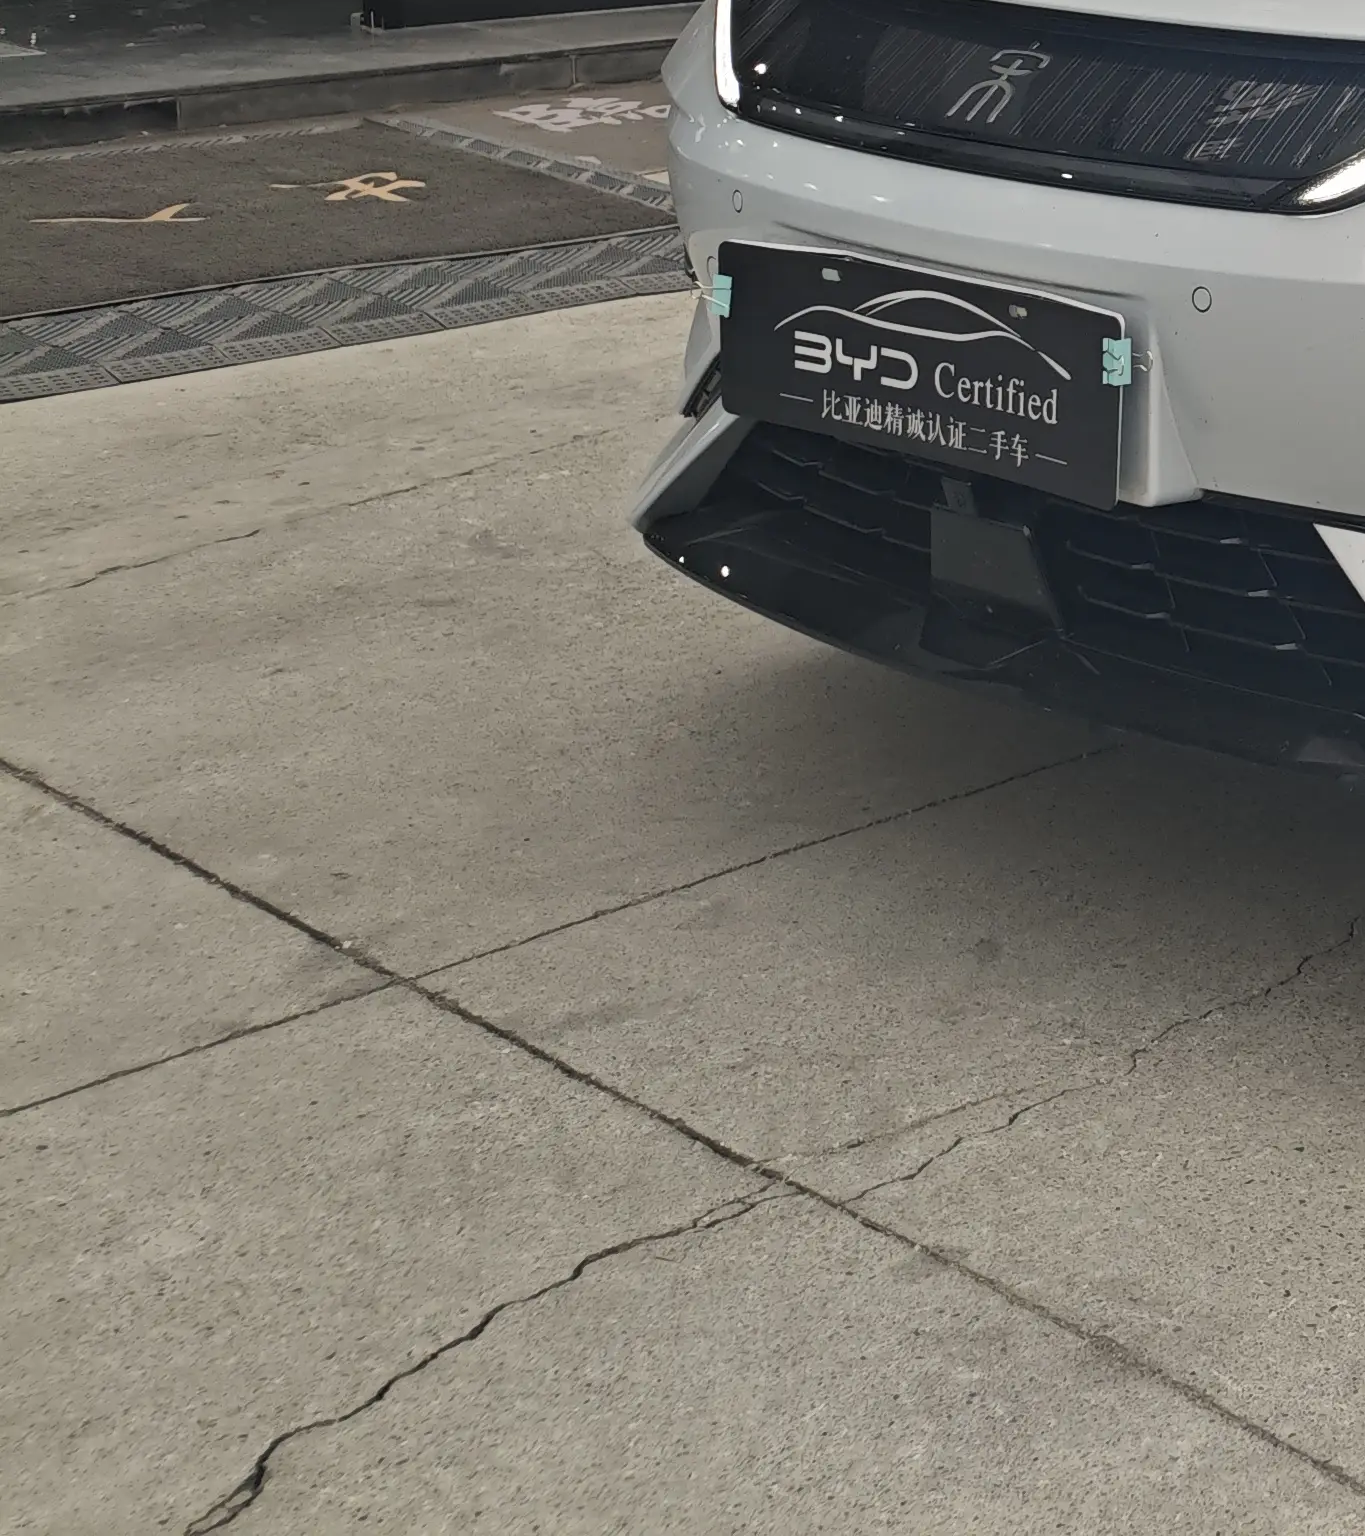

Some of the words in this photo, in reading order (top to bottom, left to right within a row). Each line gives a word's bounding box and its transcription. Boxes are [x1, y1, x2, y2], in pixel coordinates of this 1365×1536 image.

[795, 331, 918, 390] BYD
[934, 362, 1058, 424] Certified
[821, 389, 1029, 467] 比亚迪精诚认证二手车
